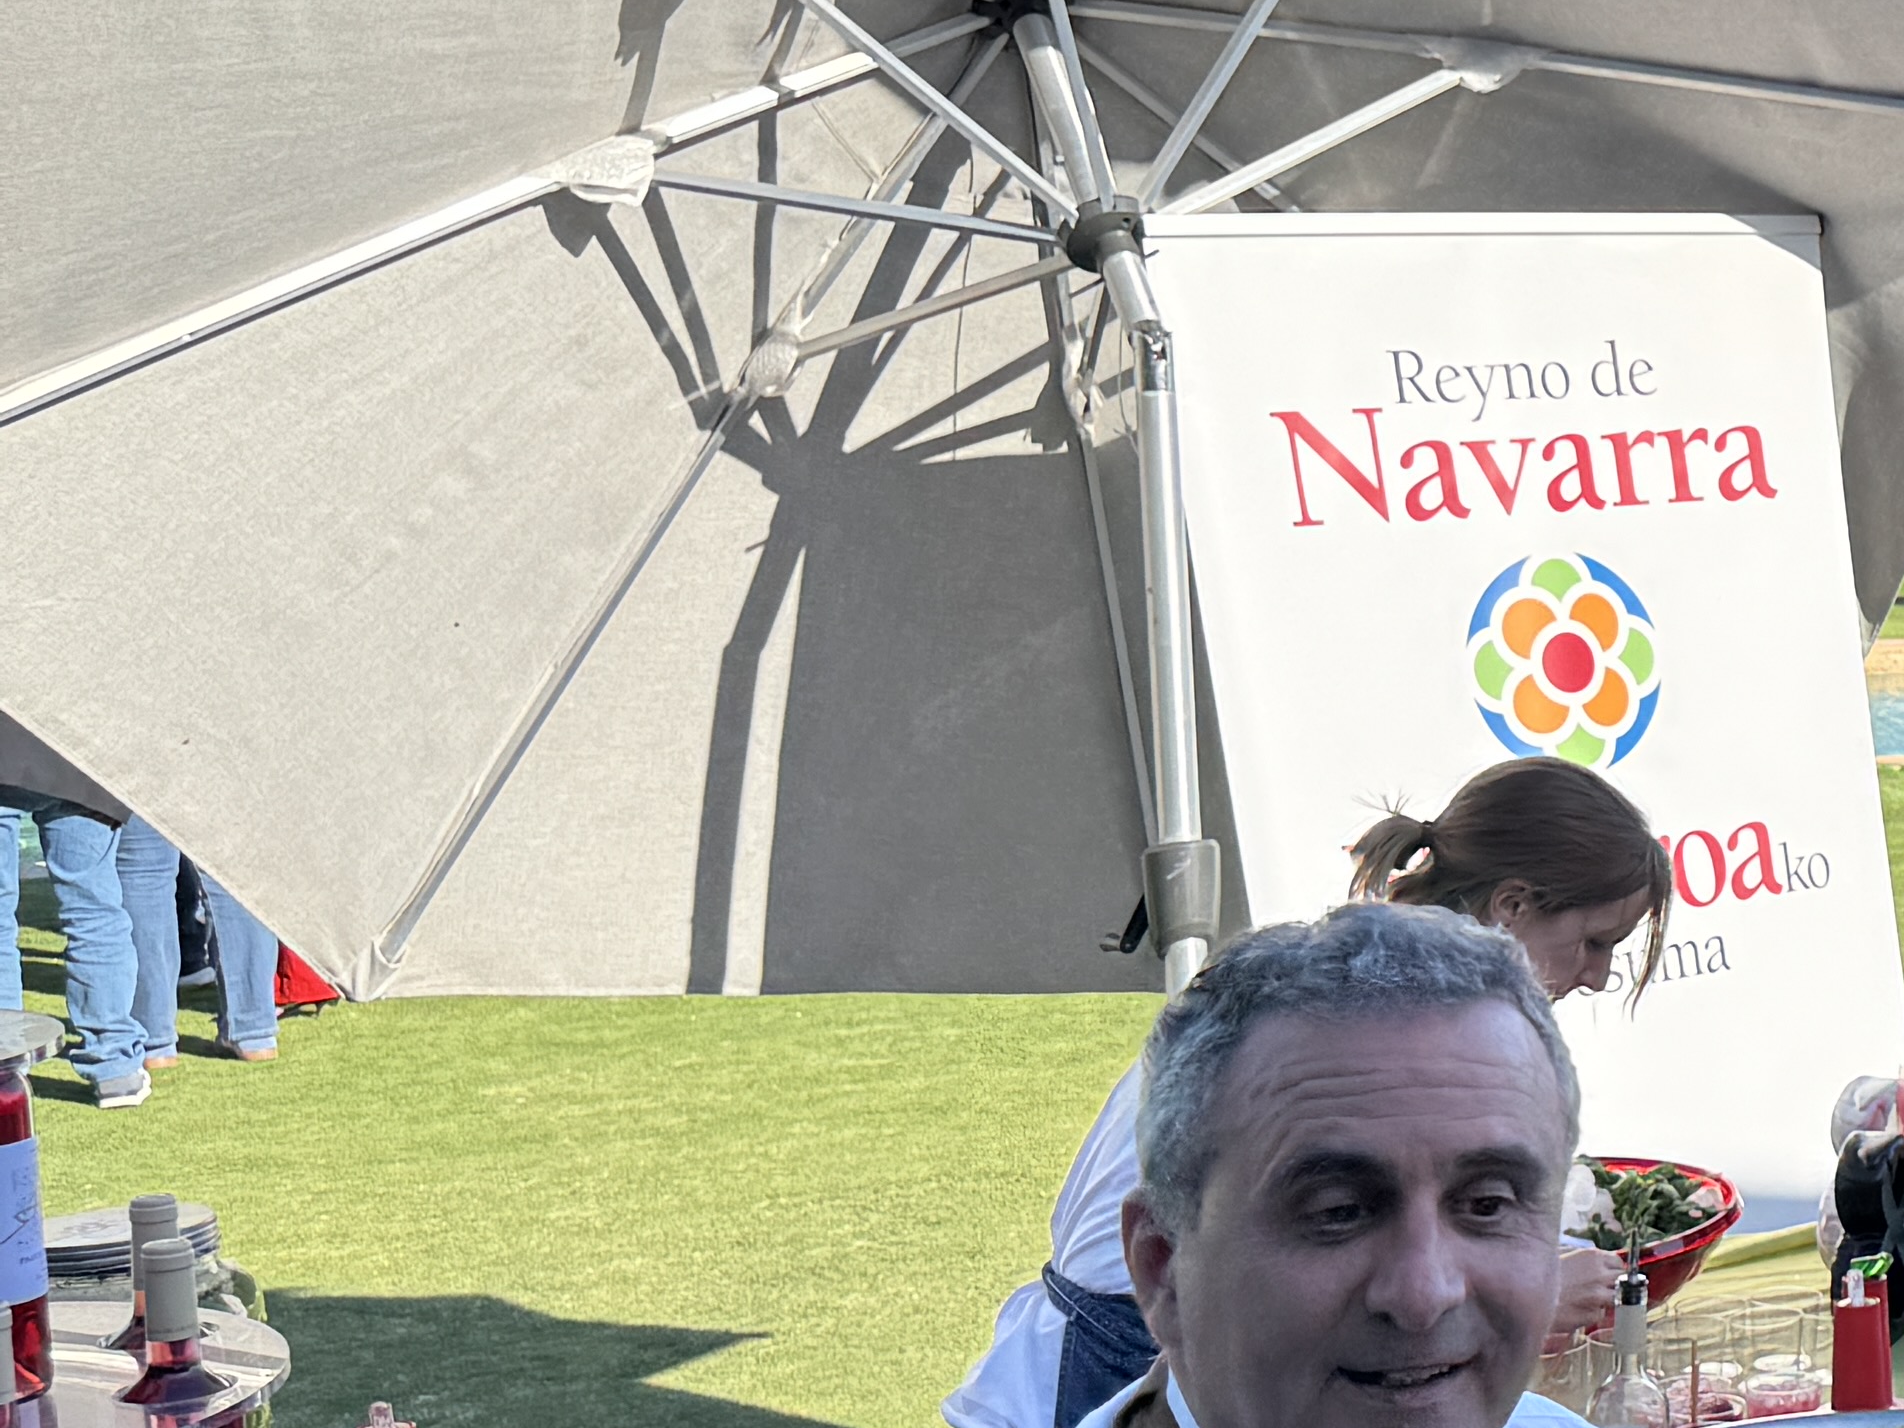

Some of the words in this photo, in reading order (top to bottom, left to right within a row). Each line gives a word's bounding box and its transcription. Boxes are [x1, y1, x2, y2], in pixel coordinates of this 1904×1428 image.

[1386, 348, 1571, 422] Reyno
[1590, 340, 1658, 398] de
[1269, 406, 1779, 528] Navarra
